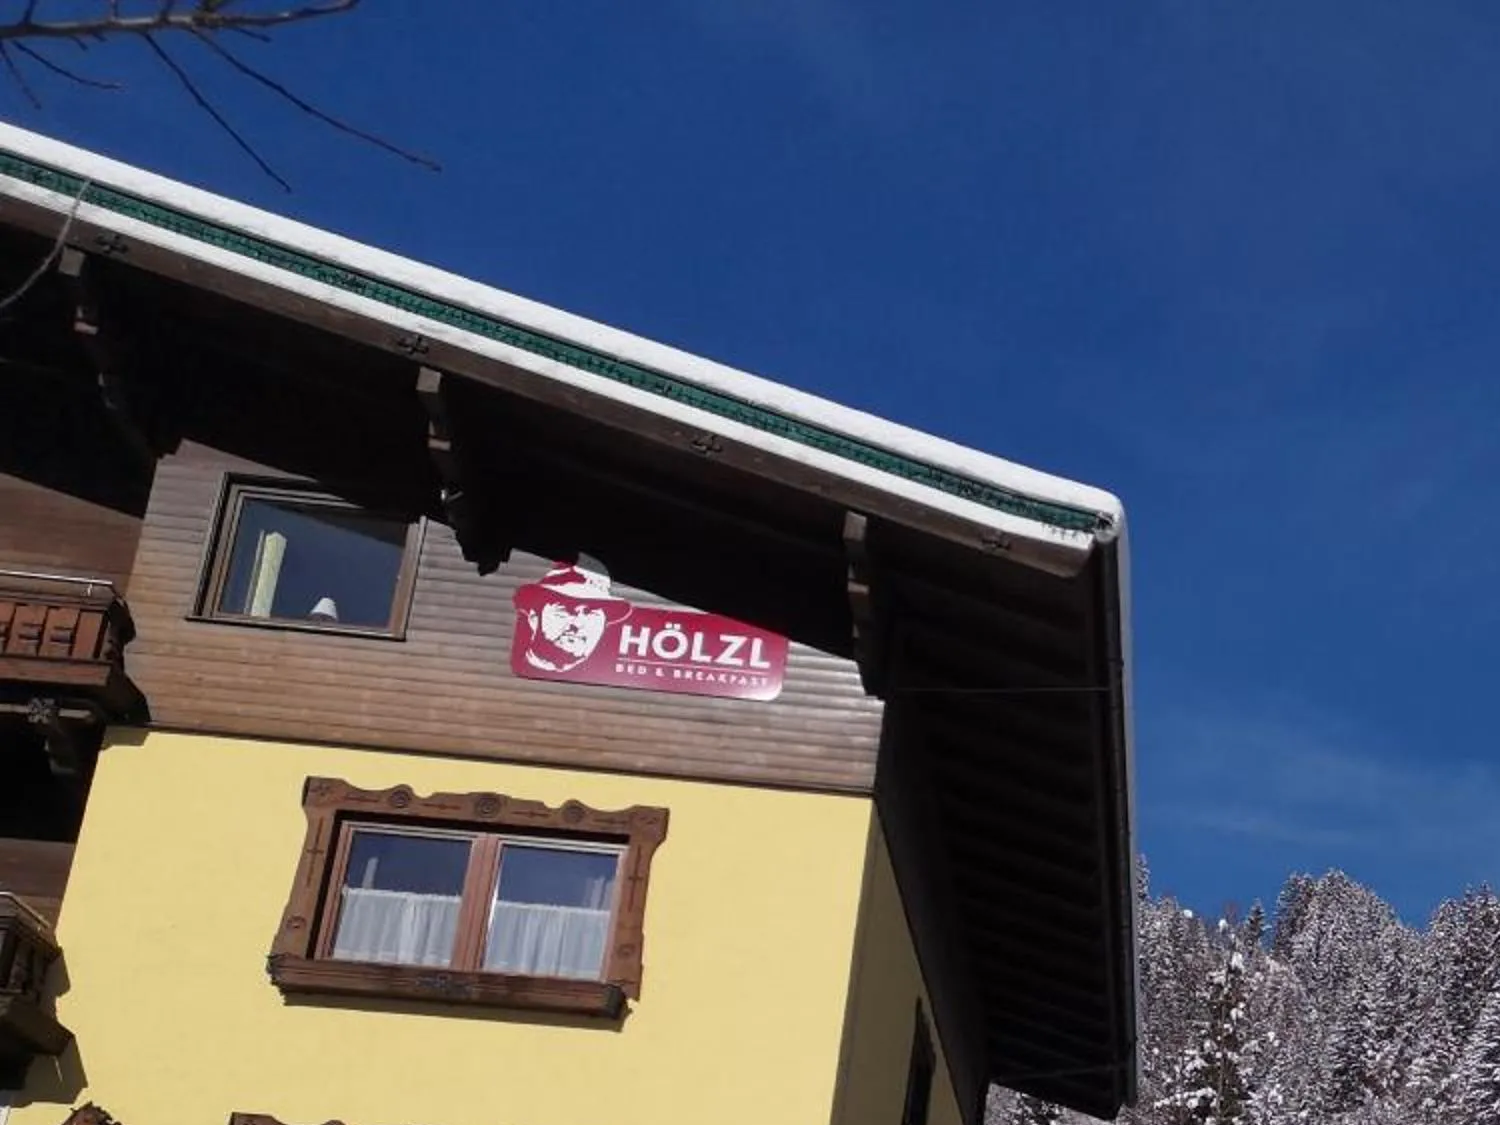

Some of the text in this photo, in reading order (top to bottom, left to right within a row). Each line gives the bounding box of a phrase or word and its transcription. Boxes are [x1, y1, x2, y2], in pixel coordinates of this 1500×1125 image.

[619, 622, 771, 669] HÖLZL
[615, 664, 769, 687] BED & BREAKFAST
